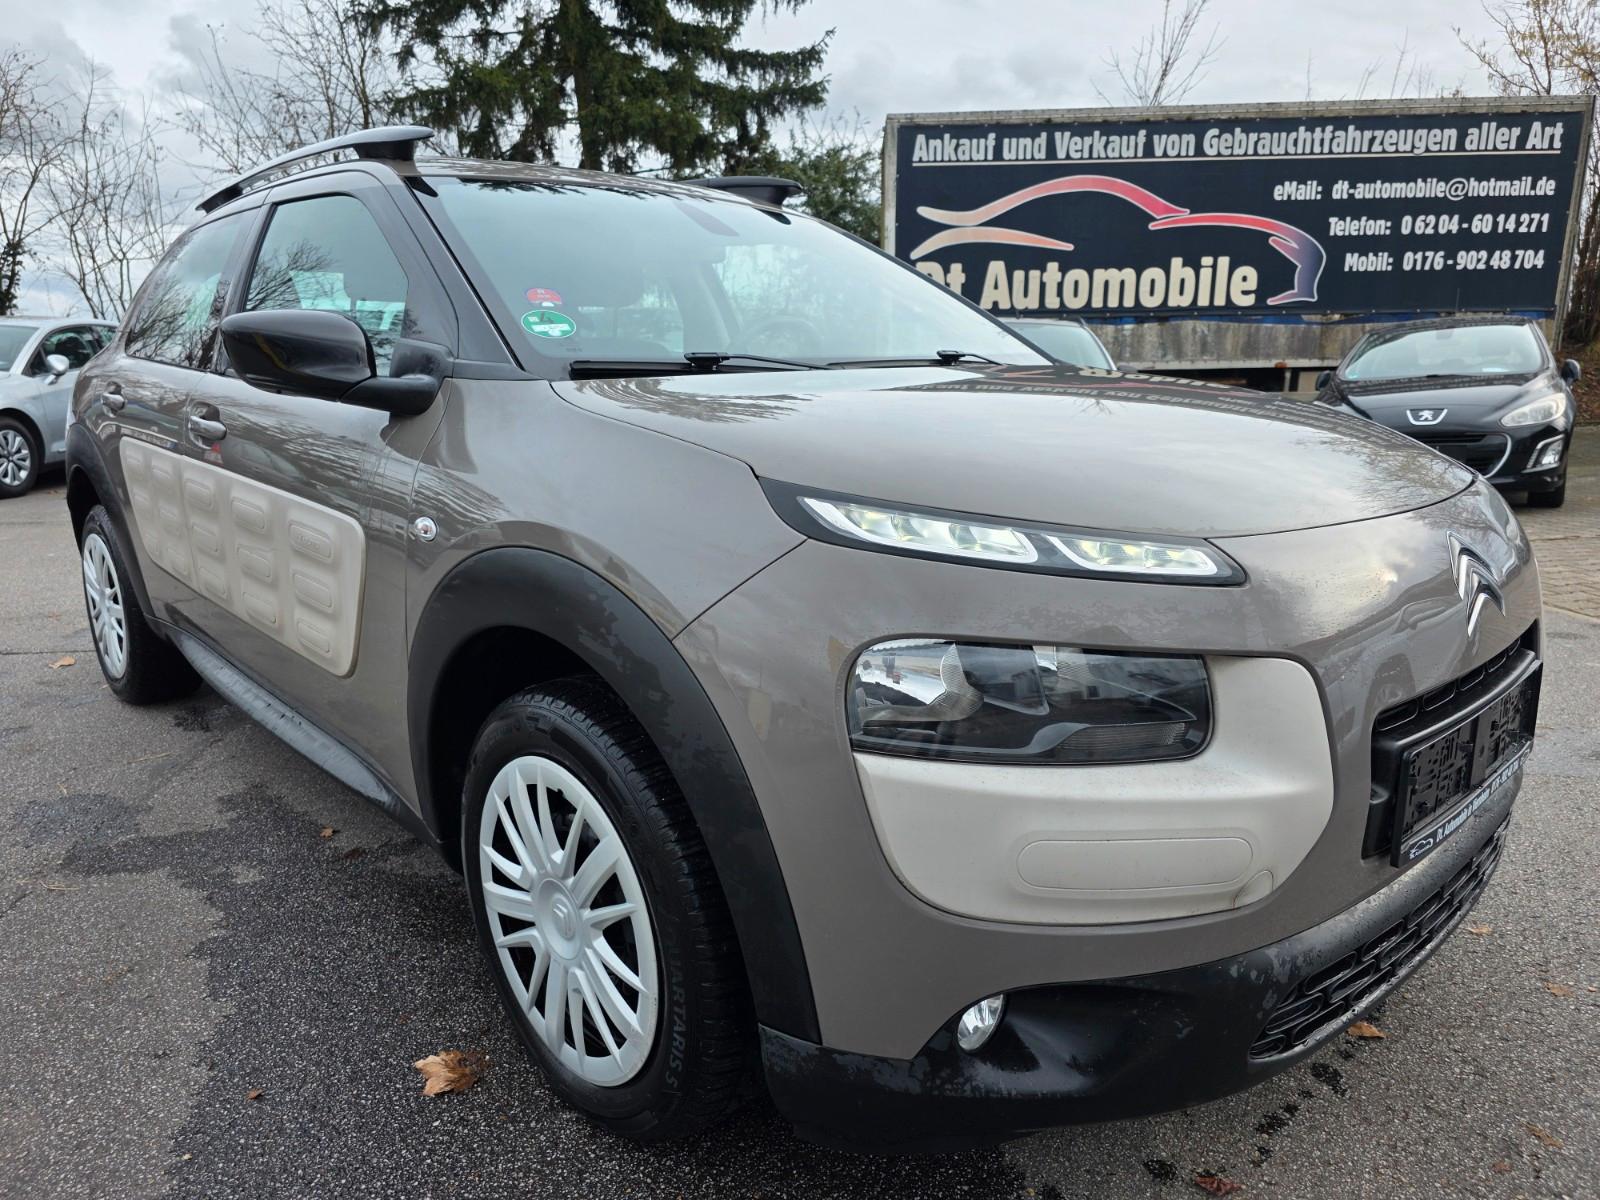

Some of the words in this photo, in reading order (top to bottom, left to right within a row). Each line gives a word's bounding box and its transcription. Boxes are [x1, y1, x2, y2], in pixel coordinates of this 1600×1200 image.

[912, 133, 996, 162] Ankauf
[1003, 132, 1047, 160] und
[1053, 130, 1147, 160] Verkauf
[1153, 133, 1195, 158] von
[1202, 126, 1458, 155] Gebrauchtfahrzeugen
[1465, 122, 1520, 151] aller
[1525, 121, 1564, 149] Art
[1273, 180, 1323, 201] eMail:
[1331, 176, 1556, 201] dt-automobile@hotmail.de
[1328, 216, 1392, 237] Telefon:
[1344, 252, 1393, 272] Mobil:
[980, 256, 1258, 309] Automobile
